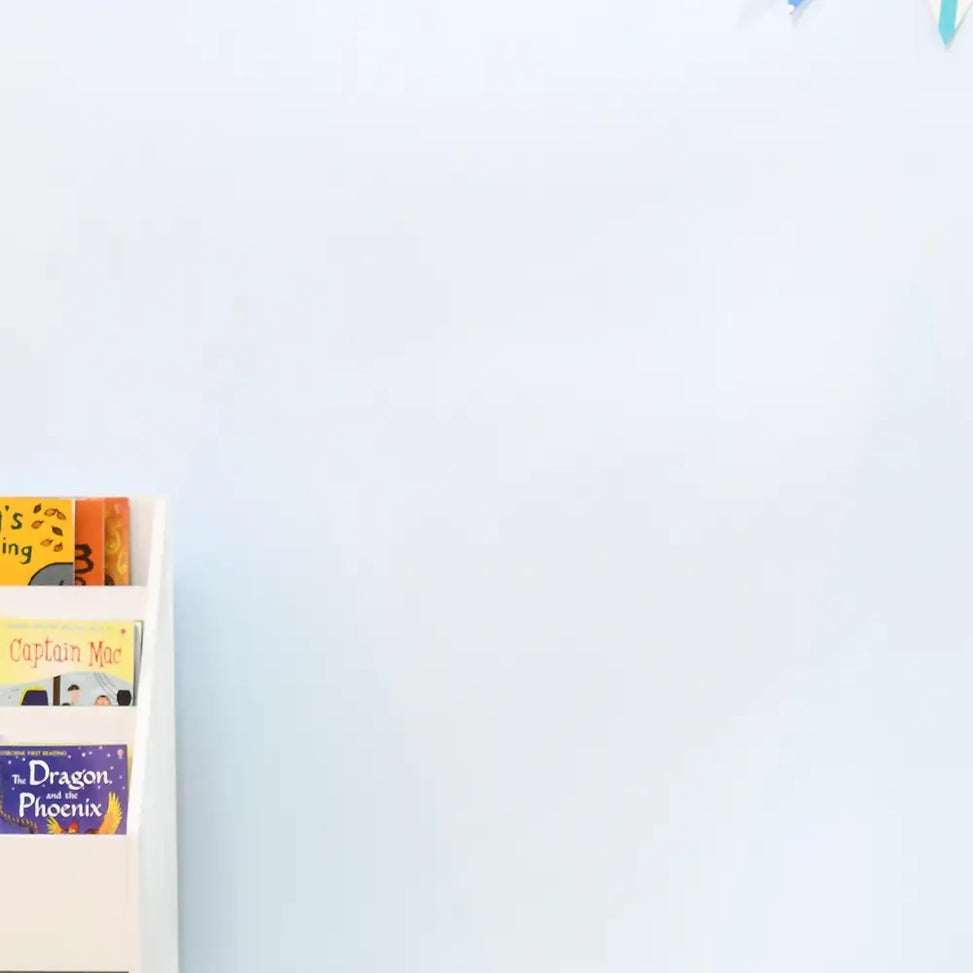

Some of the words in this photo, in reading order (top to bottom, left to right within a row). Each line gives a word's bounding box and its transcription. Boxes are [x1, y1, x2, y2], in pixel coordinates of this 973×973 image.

[10, 638, 81, 668] Captain
[89, 641, 122, 667] Mac
[12, 774, 26, 785] The
[29, 760, 109, 790] Dragon
[19, 792, 103, 817] Phoenix
[46, 791, 61, 800] and
[65, 791, 78, 800] the
